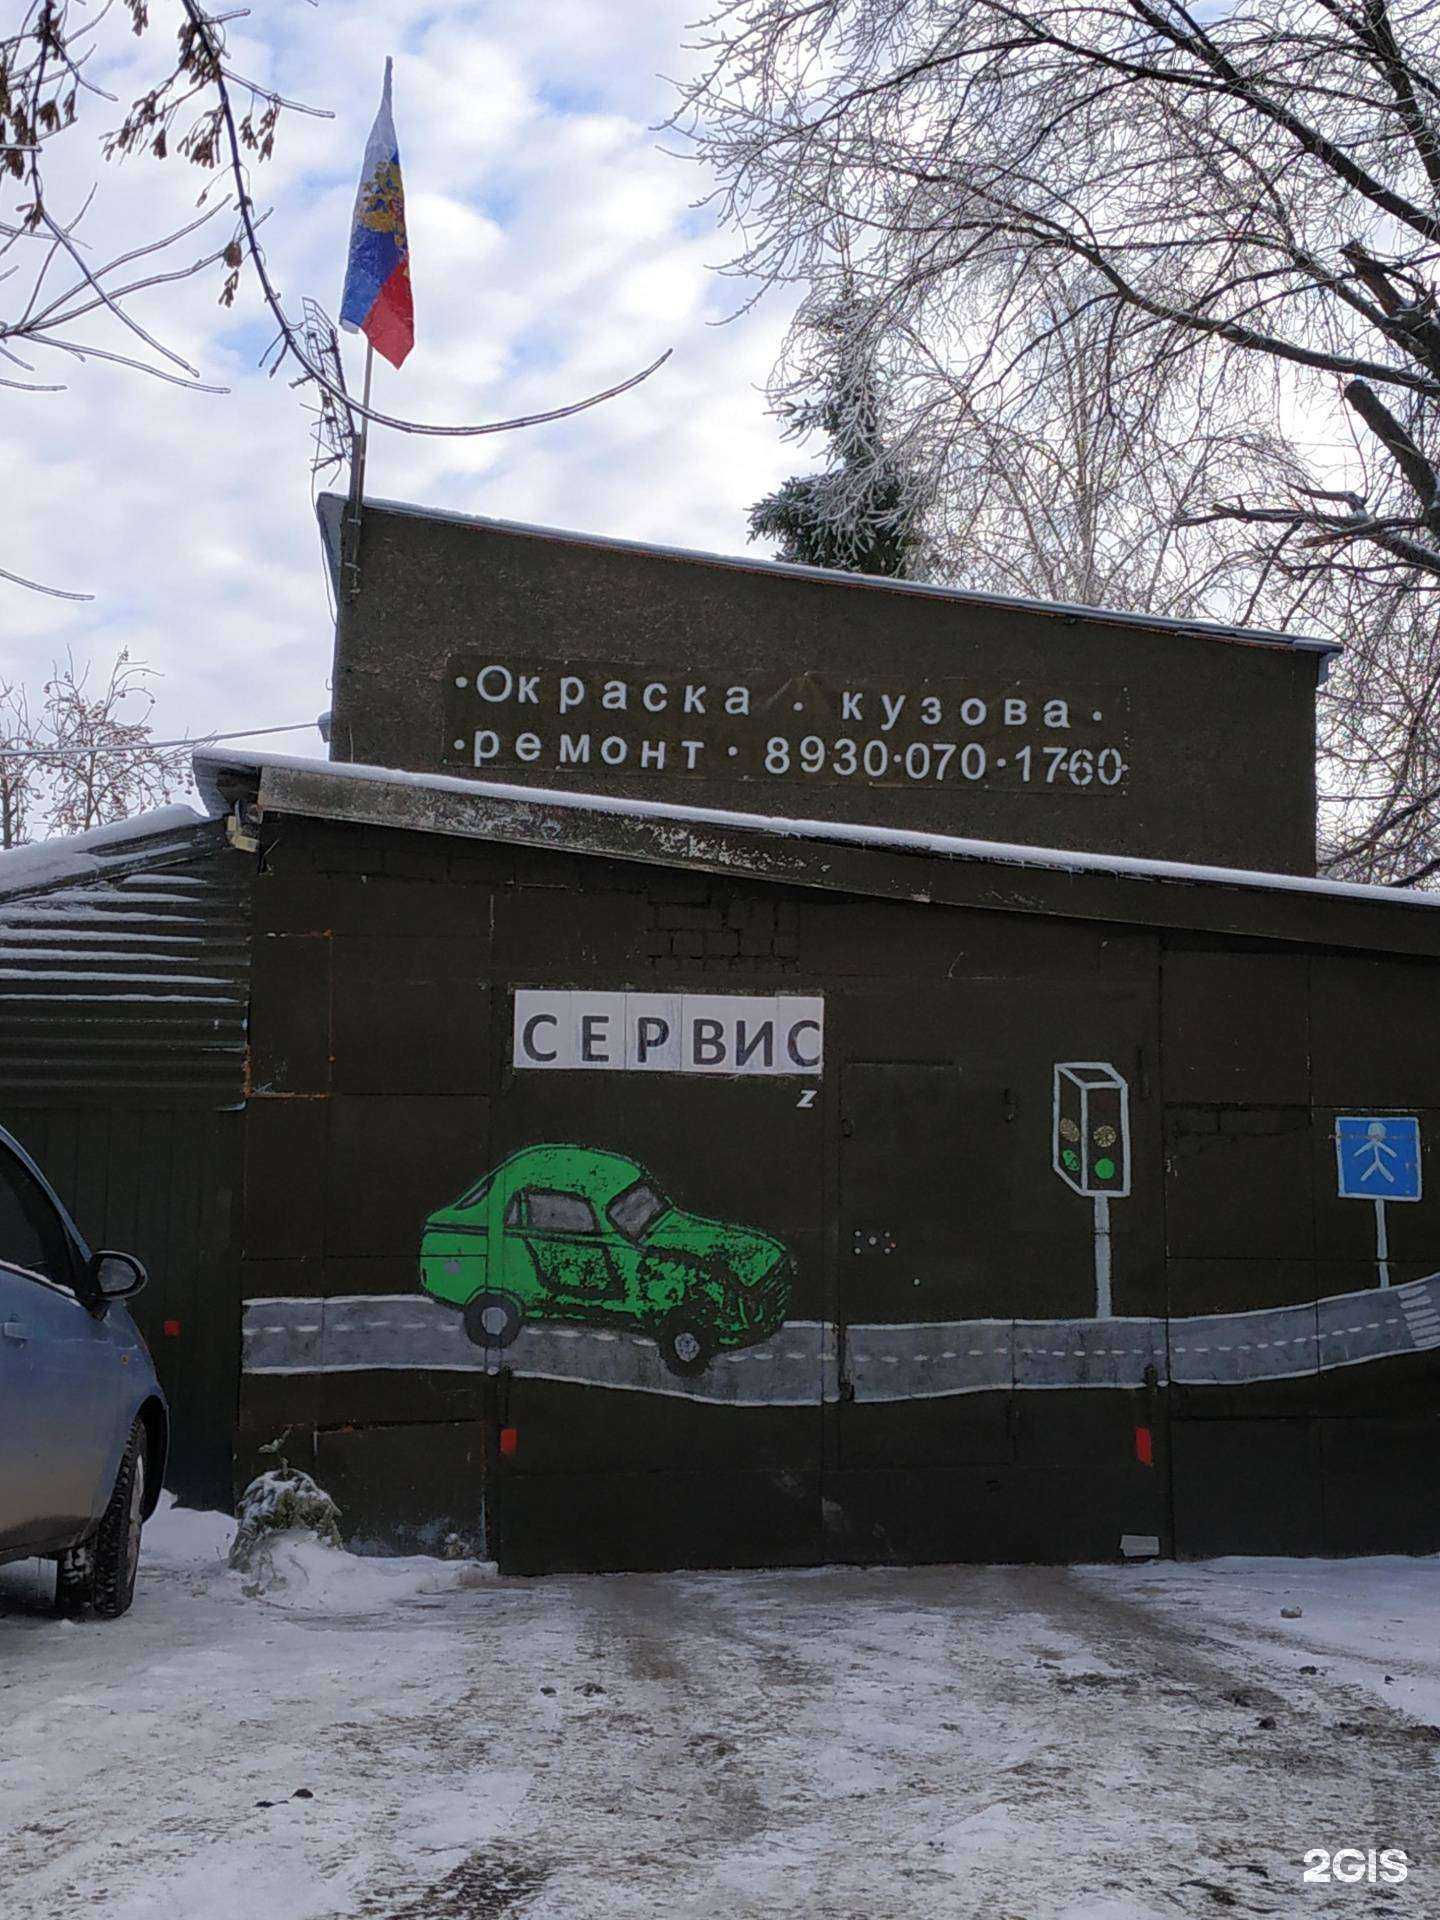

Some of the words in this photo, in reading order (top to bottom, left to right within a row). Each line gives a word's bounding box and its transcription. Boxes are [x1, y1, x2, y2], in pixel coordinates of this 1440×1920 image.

[476, 664, 750, 716] Окраска
[841, 691, 1071, 731] кузова
[473, 729, 705, 770] ремонт
[522, 1013, 821, 1068] СЕРВИС
